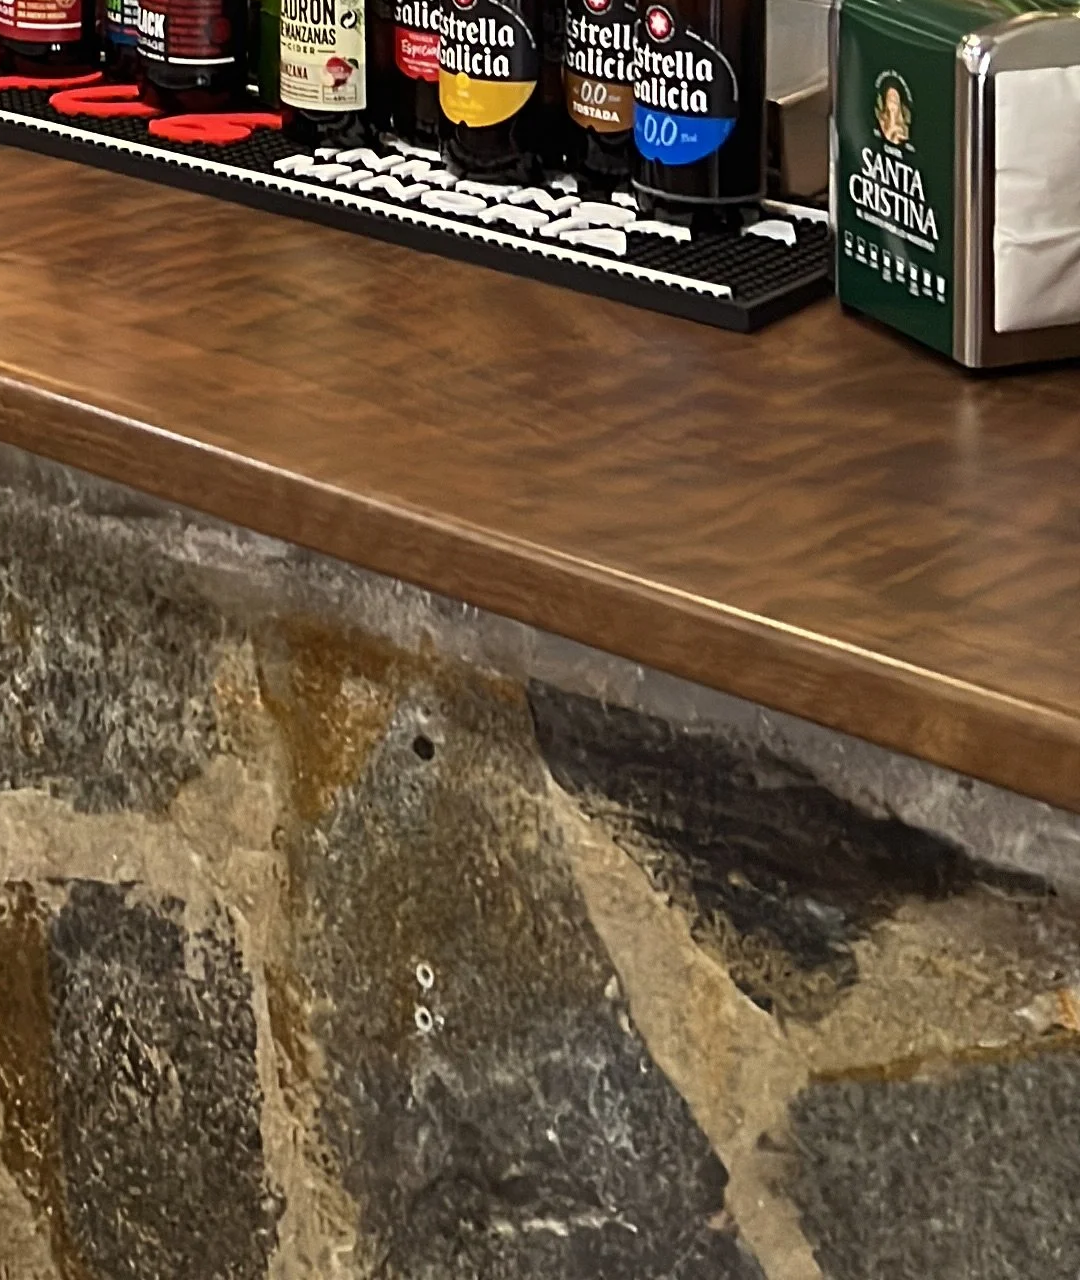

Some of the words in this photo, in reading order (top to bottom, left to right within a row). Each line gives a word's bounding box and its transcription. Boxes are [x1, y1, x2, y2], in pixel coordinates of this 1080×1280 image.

[287, 42, 316, 55] CIDER
[643, 113, 678, 147] 0,0
[861, 146, 926, 203] SANTA
[848, 173, 940, 242] CRISTINA
